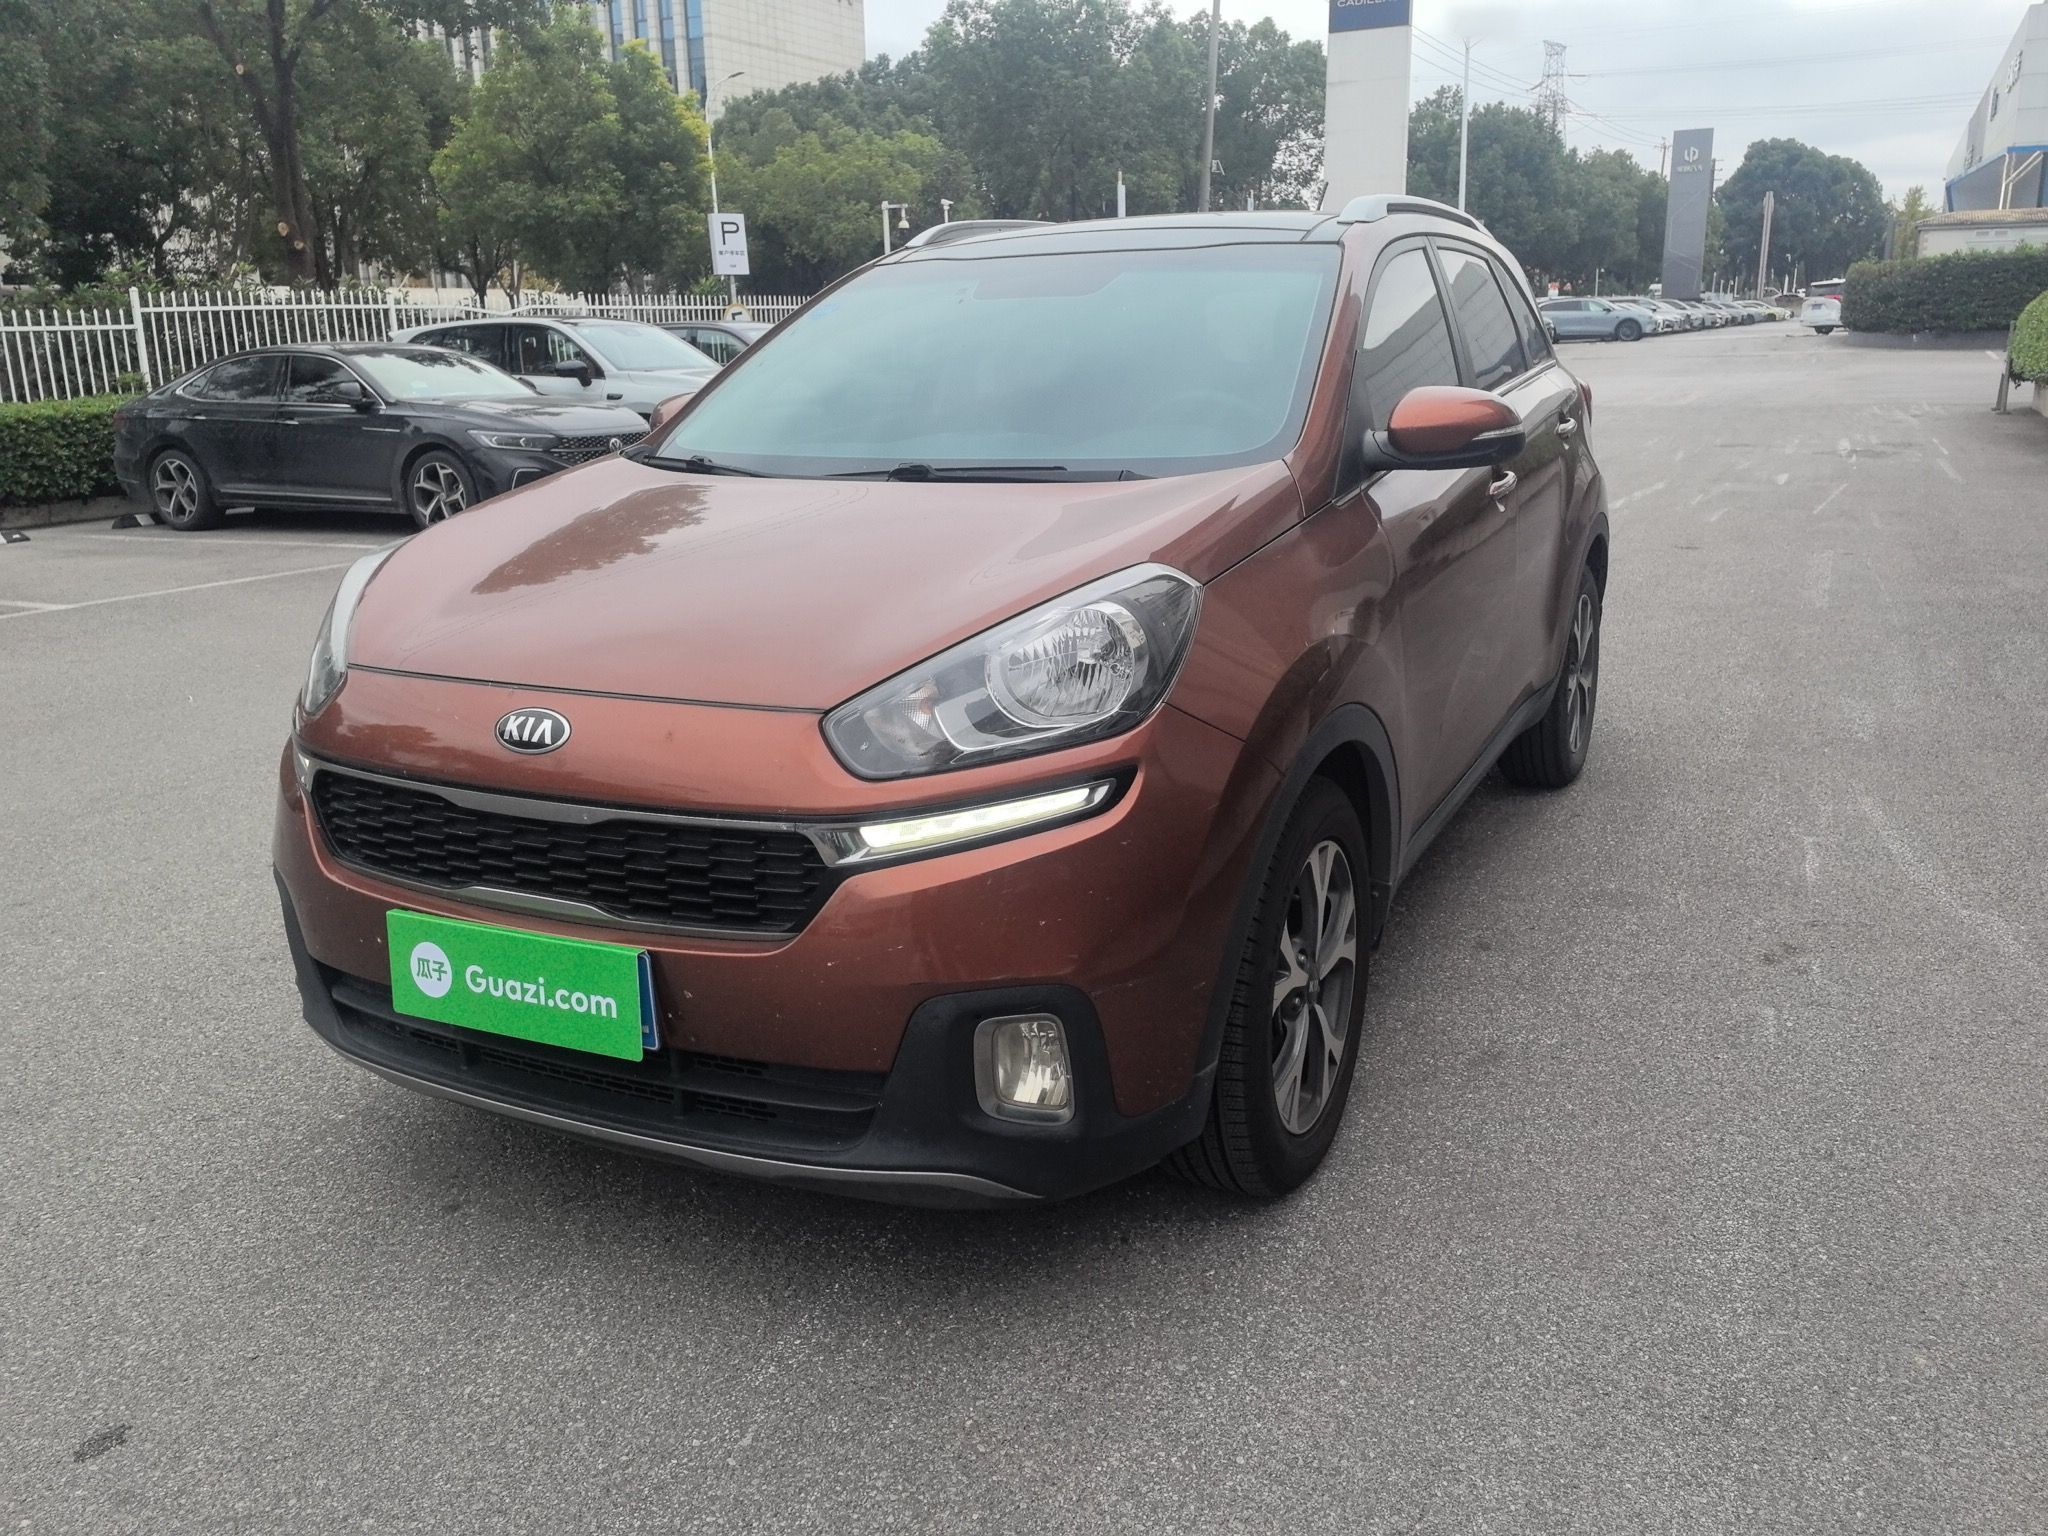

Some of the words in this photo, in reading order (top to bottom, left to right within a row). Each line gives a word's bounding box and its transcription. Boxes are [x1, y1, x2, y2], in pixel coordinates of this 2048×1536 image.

[720, 221, 740, 246] P
[503, 715, 553, 745] KIA
[416, 957, 448, 982] 瓜子
[465, 964, 618, 1019] Guazi.com
